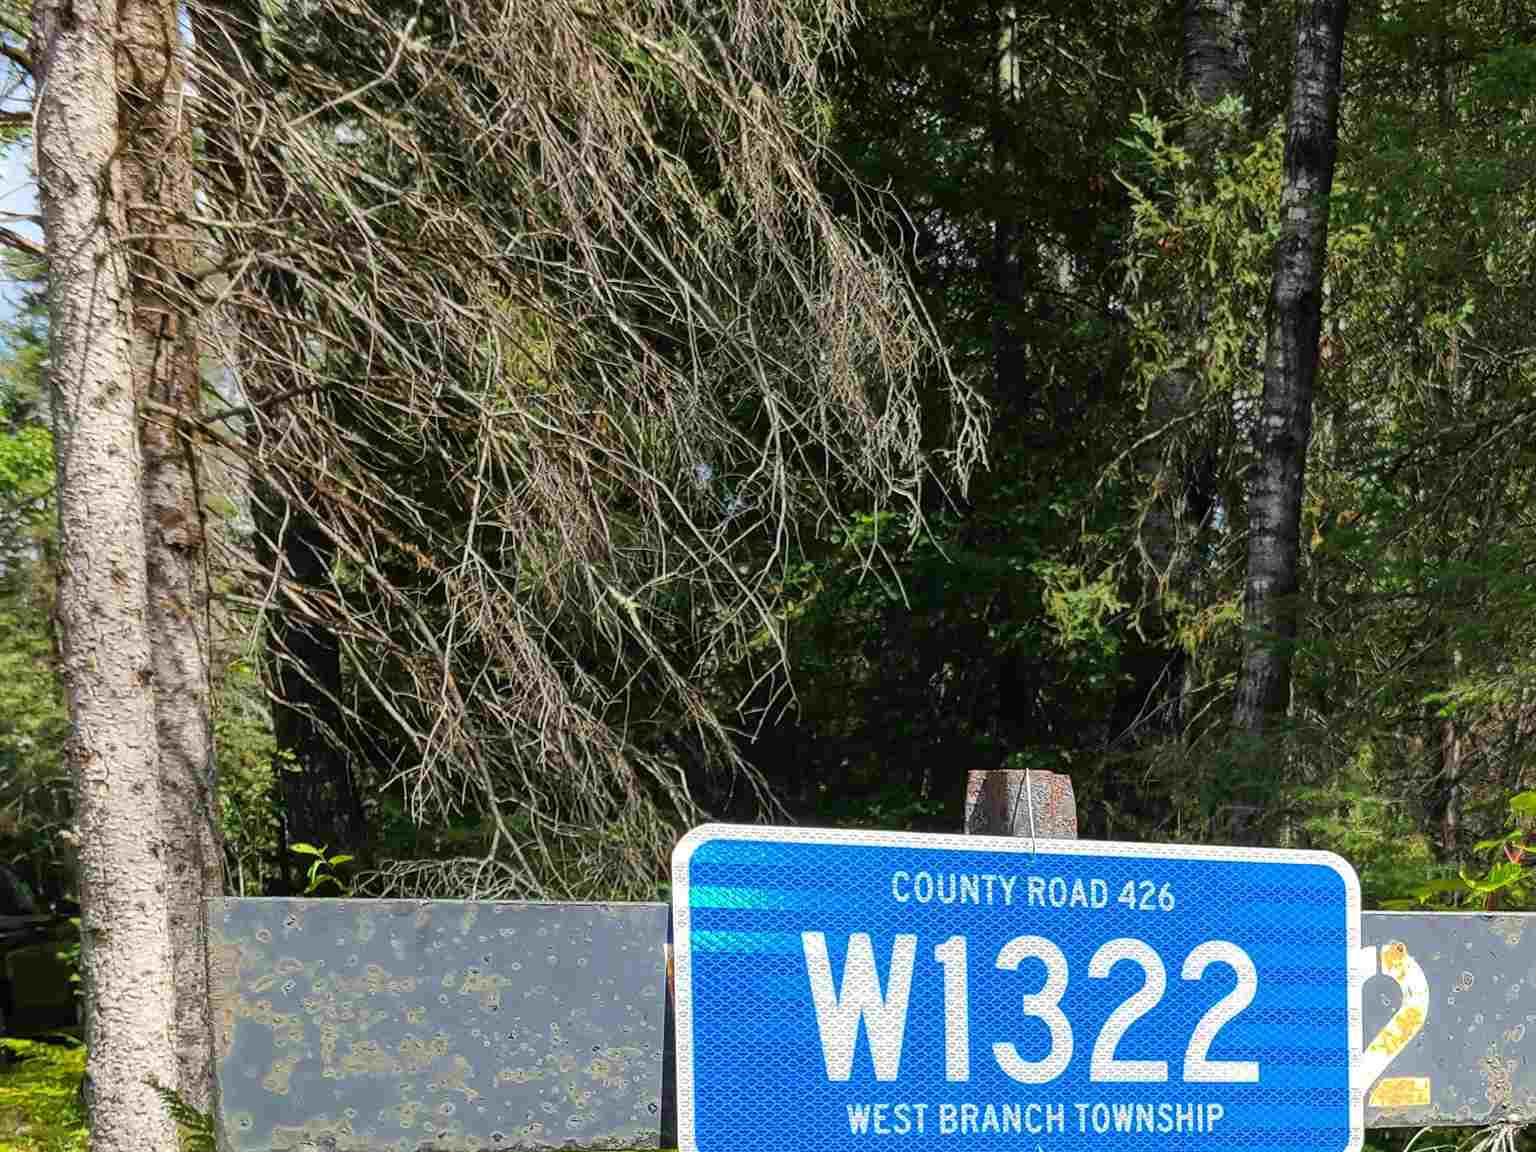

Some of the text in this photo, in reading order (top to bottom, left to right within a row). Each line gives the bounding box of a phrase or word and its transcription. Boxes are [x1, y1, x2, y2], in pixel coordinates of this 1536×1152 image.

[891, 870, 1176, 913] COUNTY ROAD 426
[801, 931, 1260, 1084] W1322
[846, 1102, 1225, 1135] WEST BRANCH TOWNSHIP
